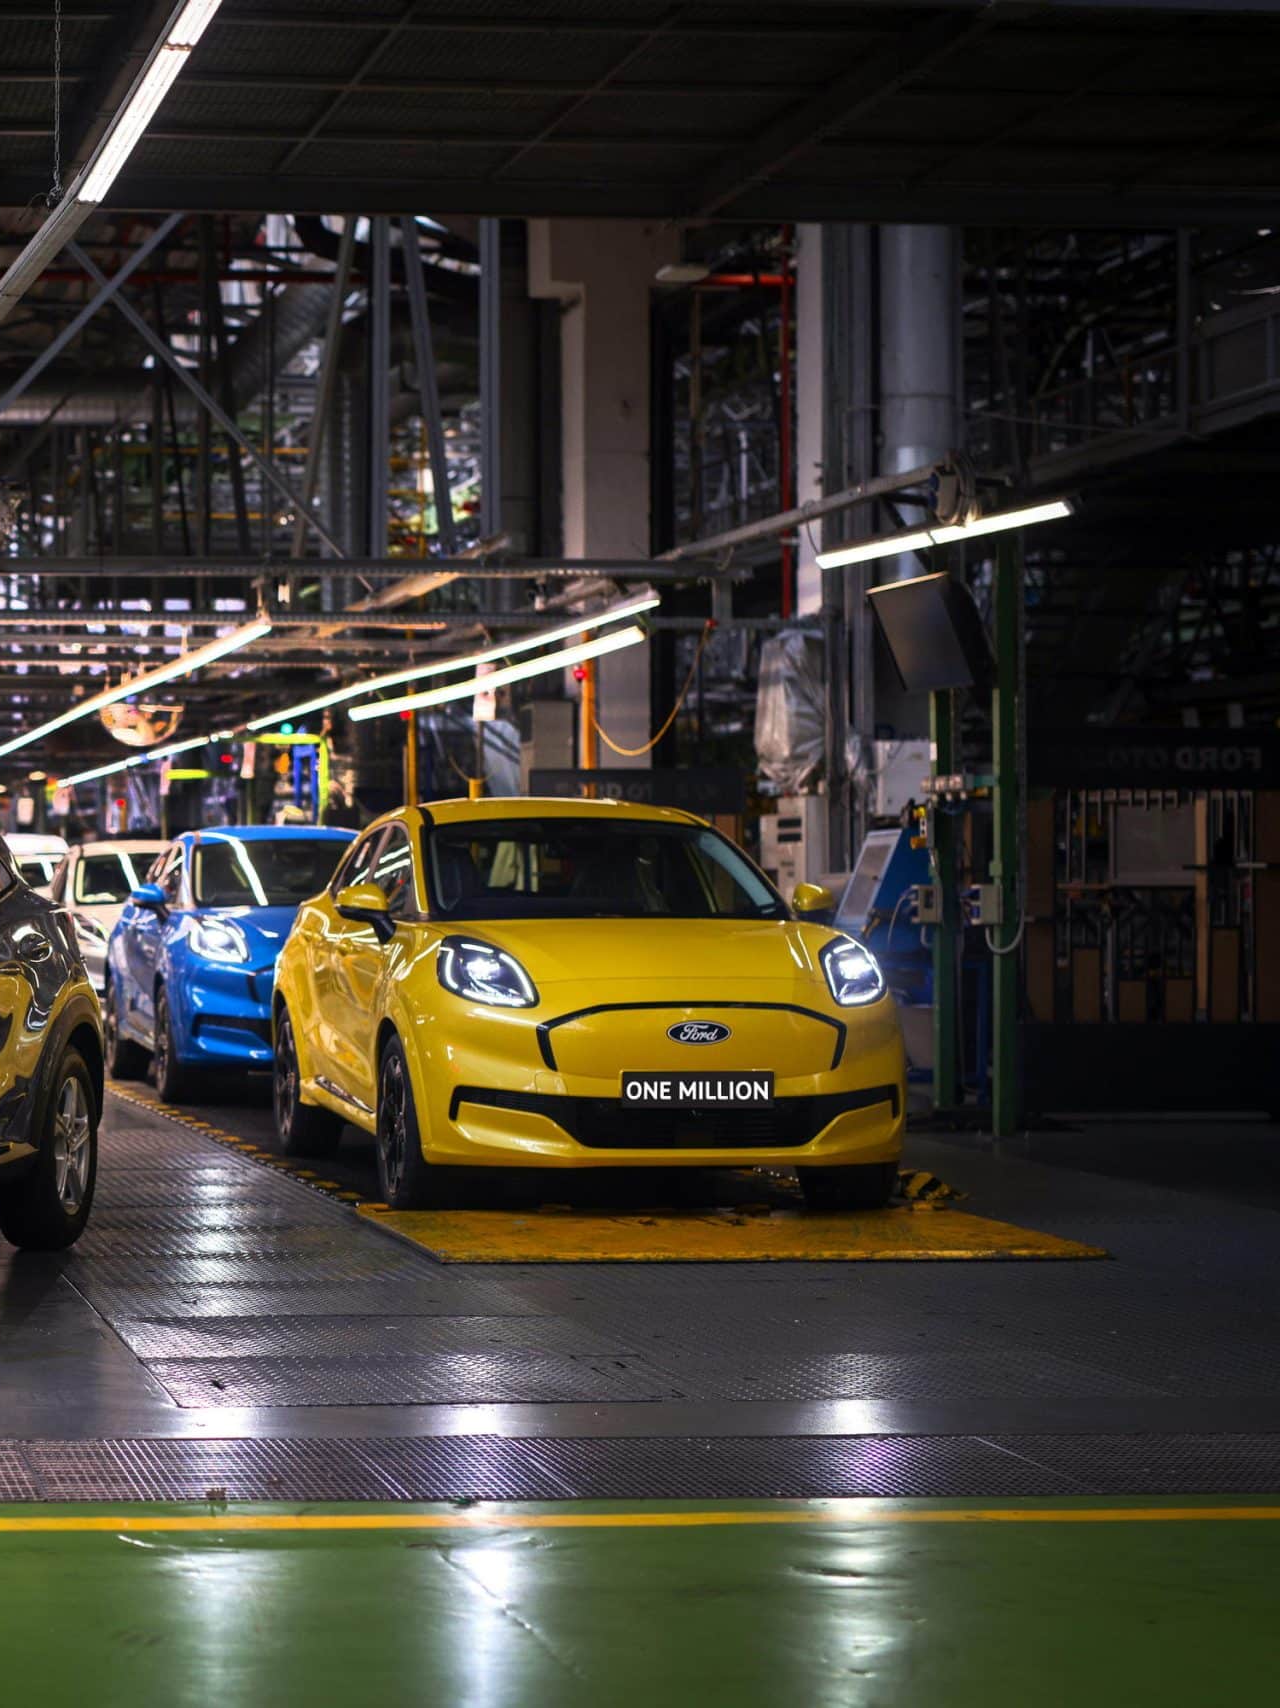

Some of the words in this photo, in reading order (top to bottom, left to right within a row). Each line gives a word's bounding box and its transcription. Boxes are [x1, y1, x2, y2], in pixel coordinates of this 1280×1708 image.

[679, 1023, 719, 1041] Ford
[626, 1081, 671, 1100] ONE
[679, 1081, 769, 1100] MILLION
